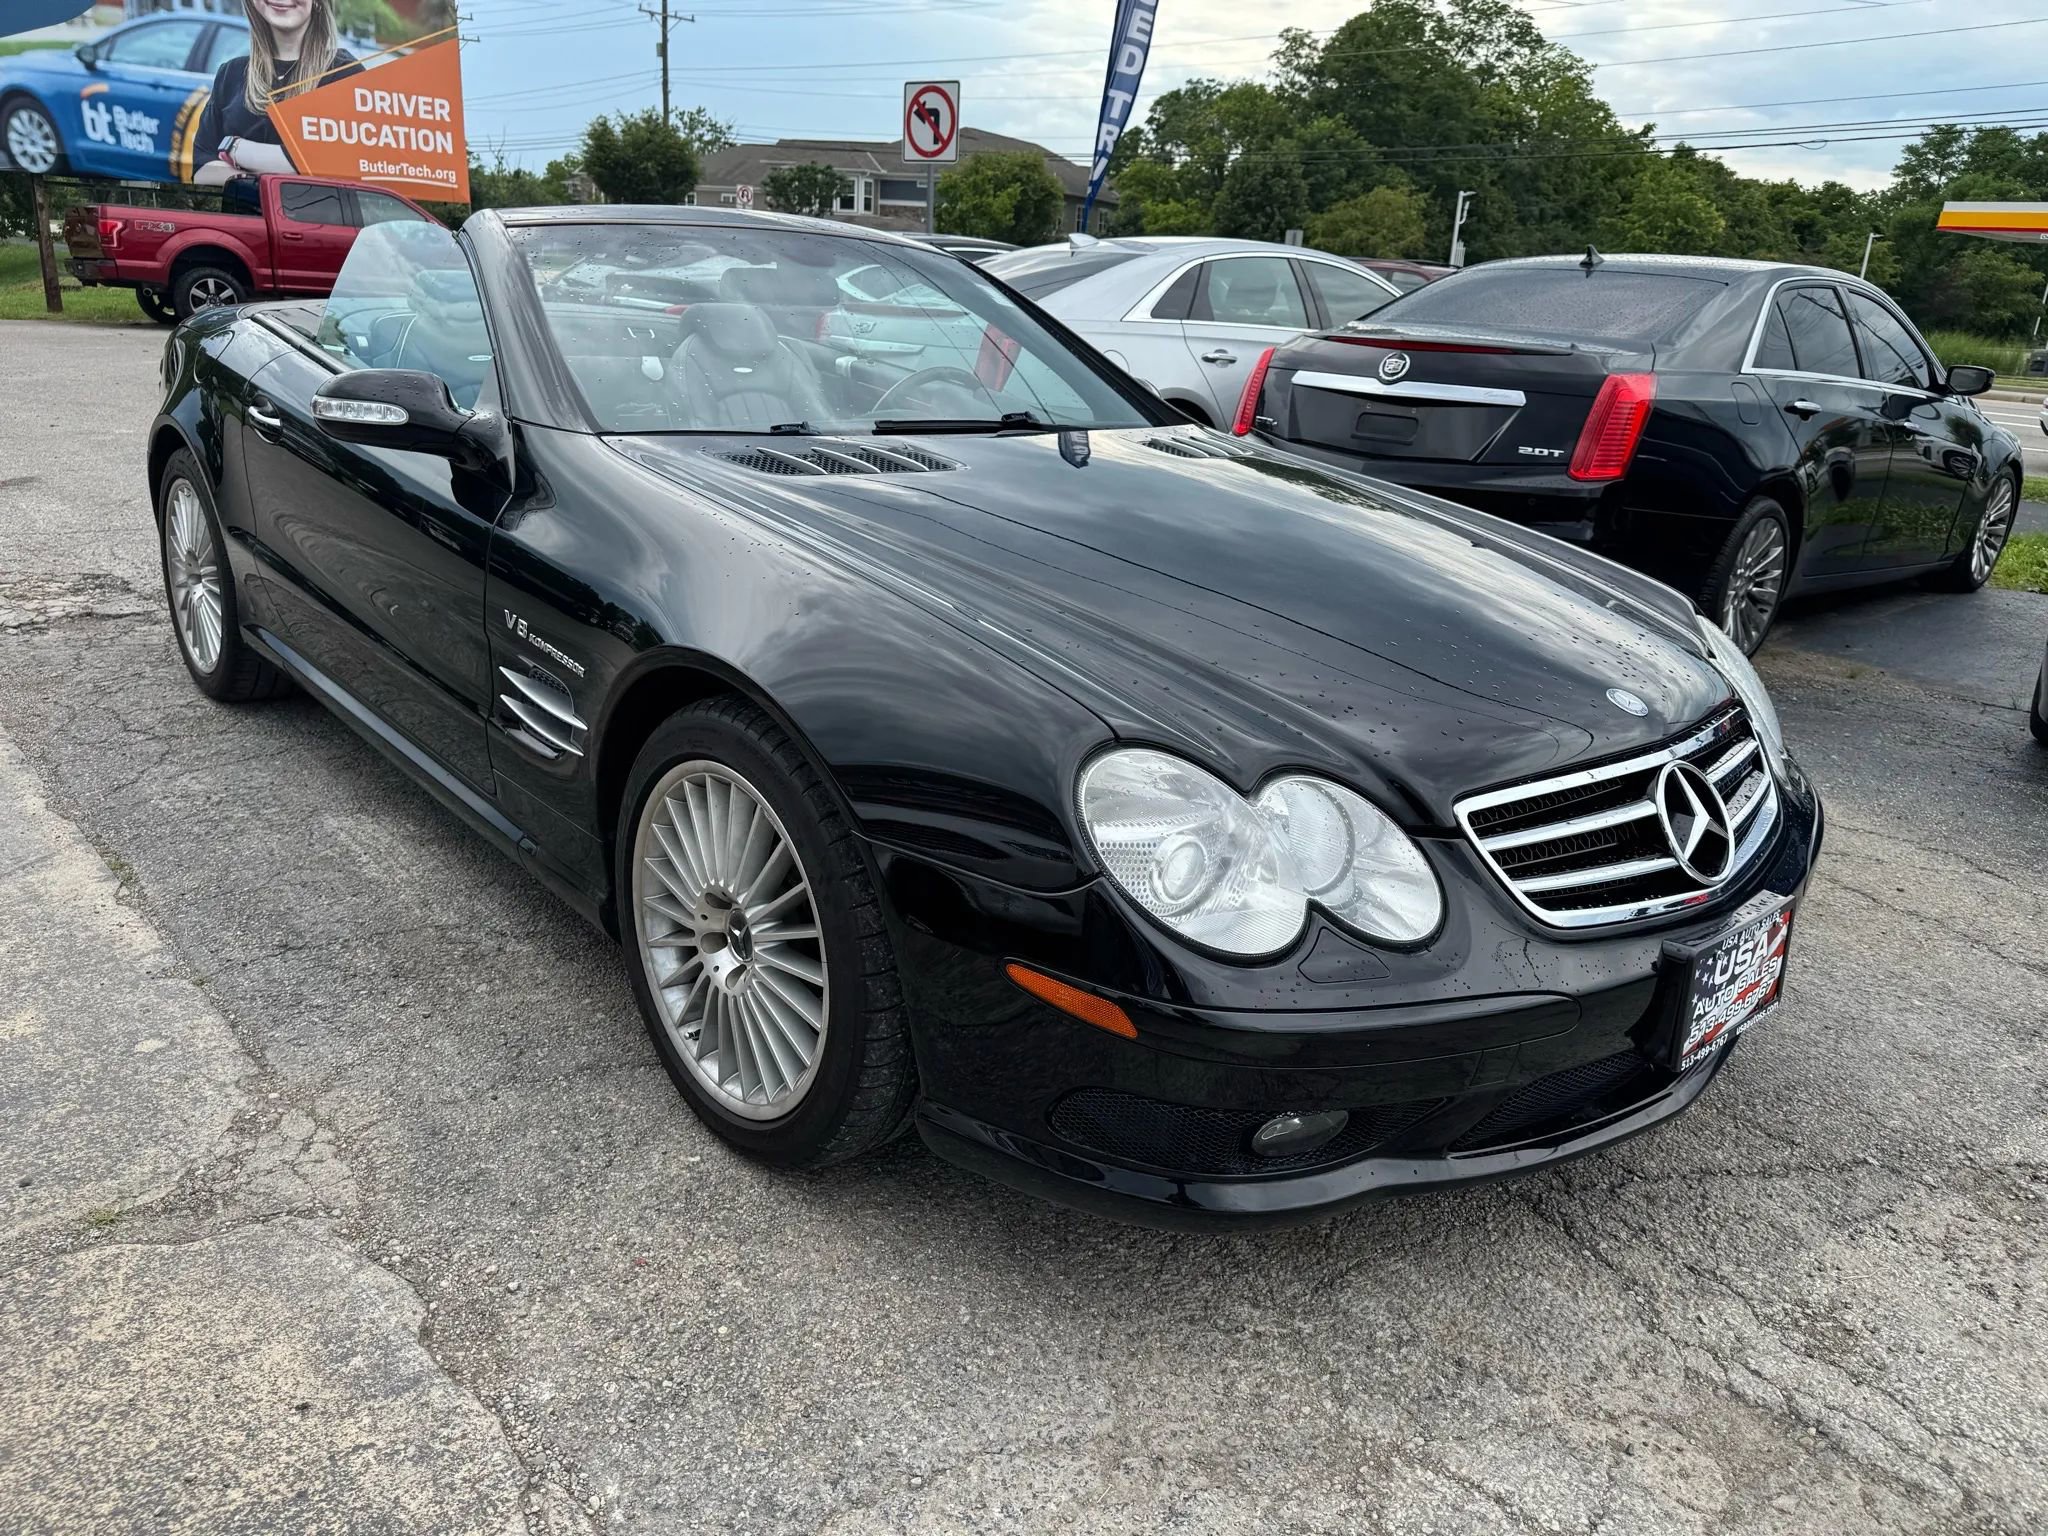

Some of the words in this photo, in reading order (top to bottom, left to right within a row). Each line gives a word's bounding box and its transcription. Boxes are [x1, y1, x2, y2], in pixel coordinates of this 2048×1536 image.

[112, 105, 160, 135] Butler
[354, 87, 451, 122] DRIVER
[119, 129, 155, 154] Tech
[301, 116, 454, 155] EDUCATION
[359, 159, 456, 183] ButlerTech.org
[135, 220, 176, 233] FX4
[528, 633, 585, 678] KOMPRESSOR
[1714, 931, 1769, 986] USA
[1722, 934, 1738, 951] USA
[1693, 983, 1735, 1019] AUTO
[1735, 956, 1778, 994] SALES
[1680, 1032, 1729, 1072] 513-499-6767
